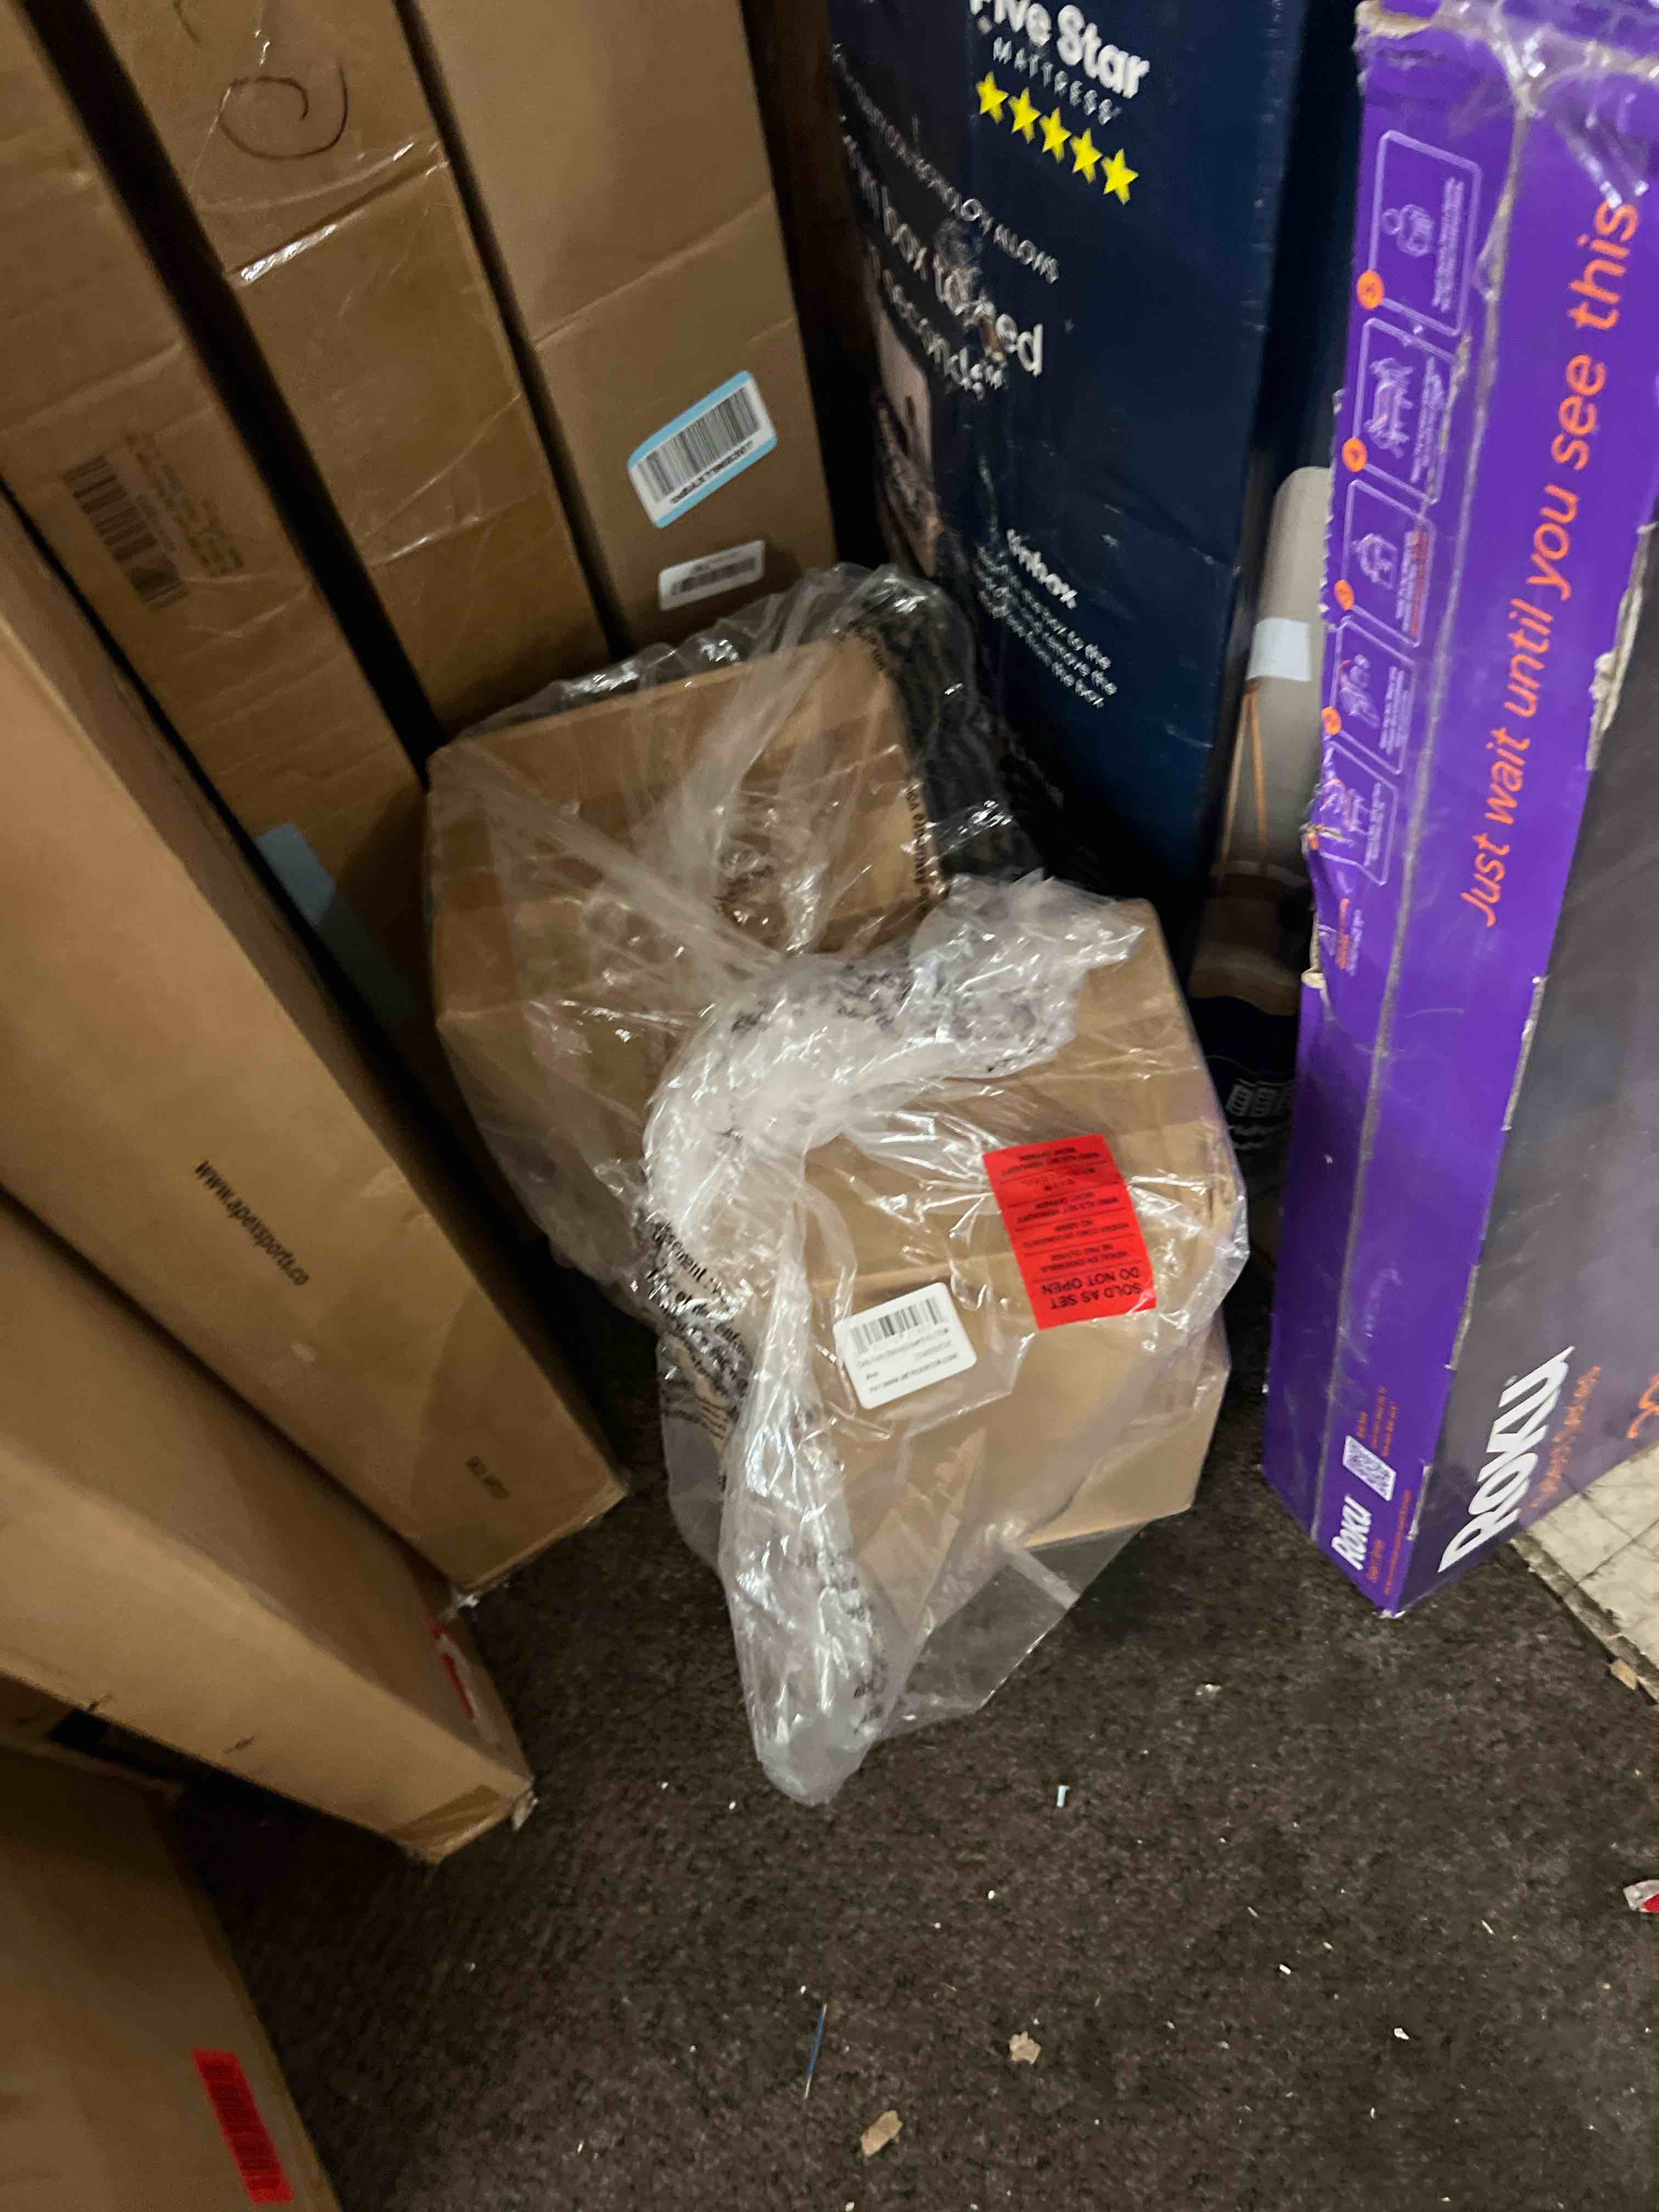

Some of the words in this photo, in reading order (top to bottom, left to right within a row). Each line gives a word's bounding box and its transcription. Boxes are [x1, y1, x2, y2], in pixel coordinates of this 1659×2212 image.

[969, 0, 1052, 46] ive
[1057, 4, 1150, 99] Star
[1568, 200, 1639, 329] this
[1551, 354, 1606, 470] see
[1527, 484, 1580, 601] you
[1504, 598, 1555, 718] until
[1483, 726, 1531, 826] wait
[1460, 832, 1510, 927] Just
[1042, 1277, 1083, 1294] OPEN
[1050, 1294, 1079, 1310] SET
[1080, 1290, 1101, 1304] AS
[1088, 1272, 1116, 1286] NOT
[1103, 1282, 1142, 1298] SOLD
[1119, 1266, 1142, 1280] DO
